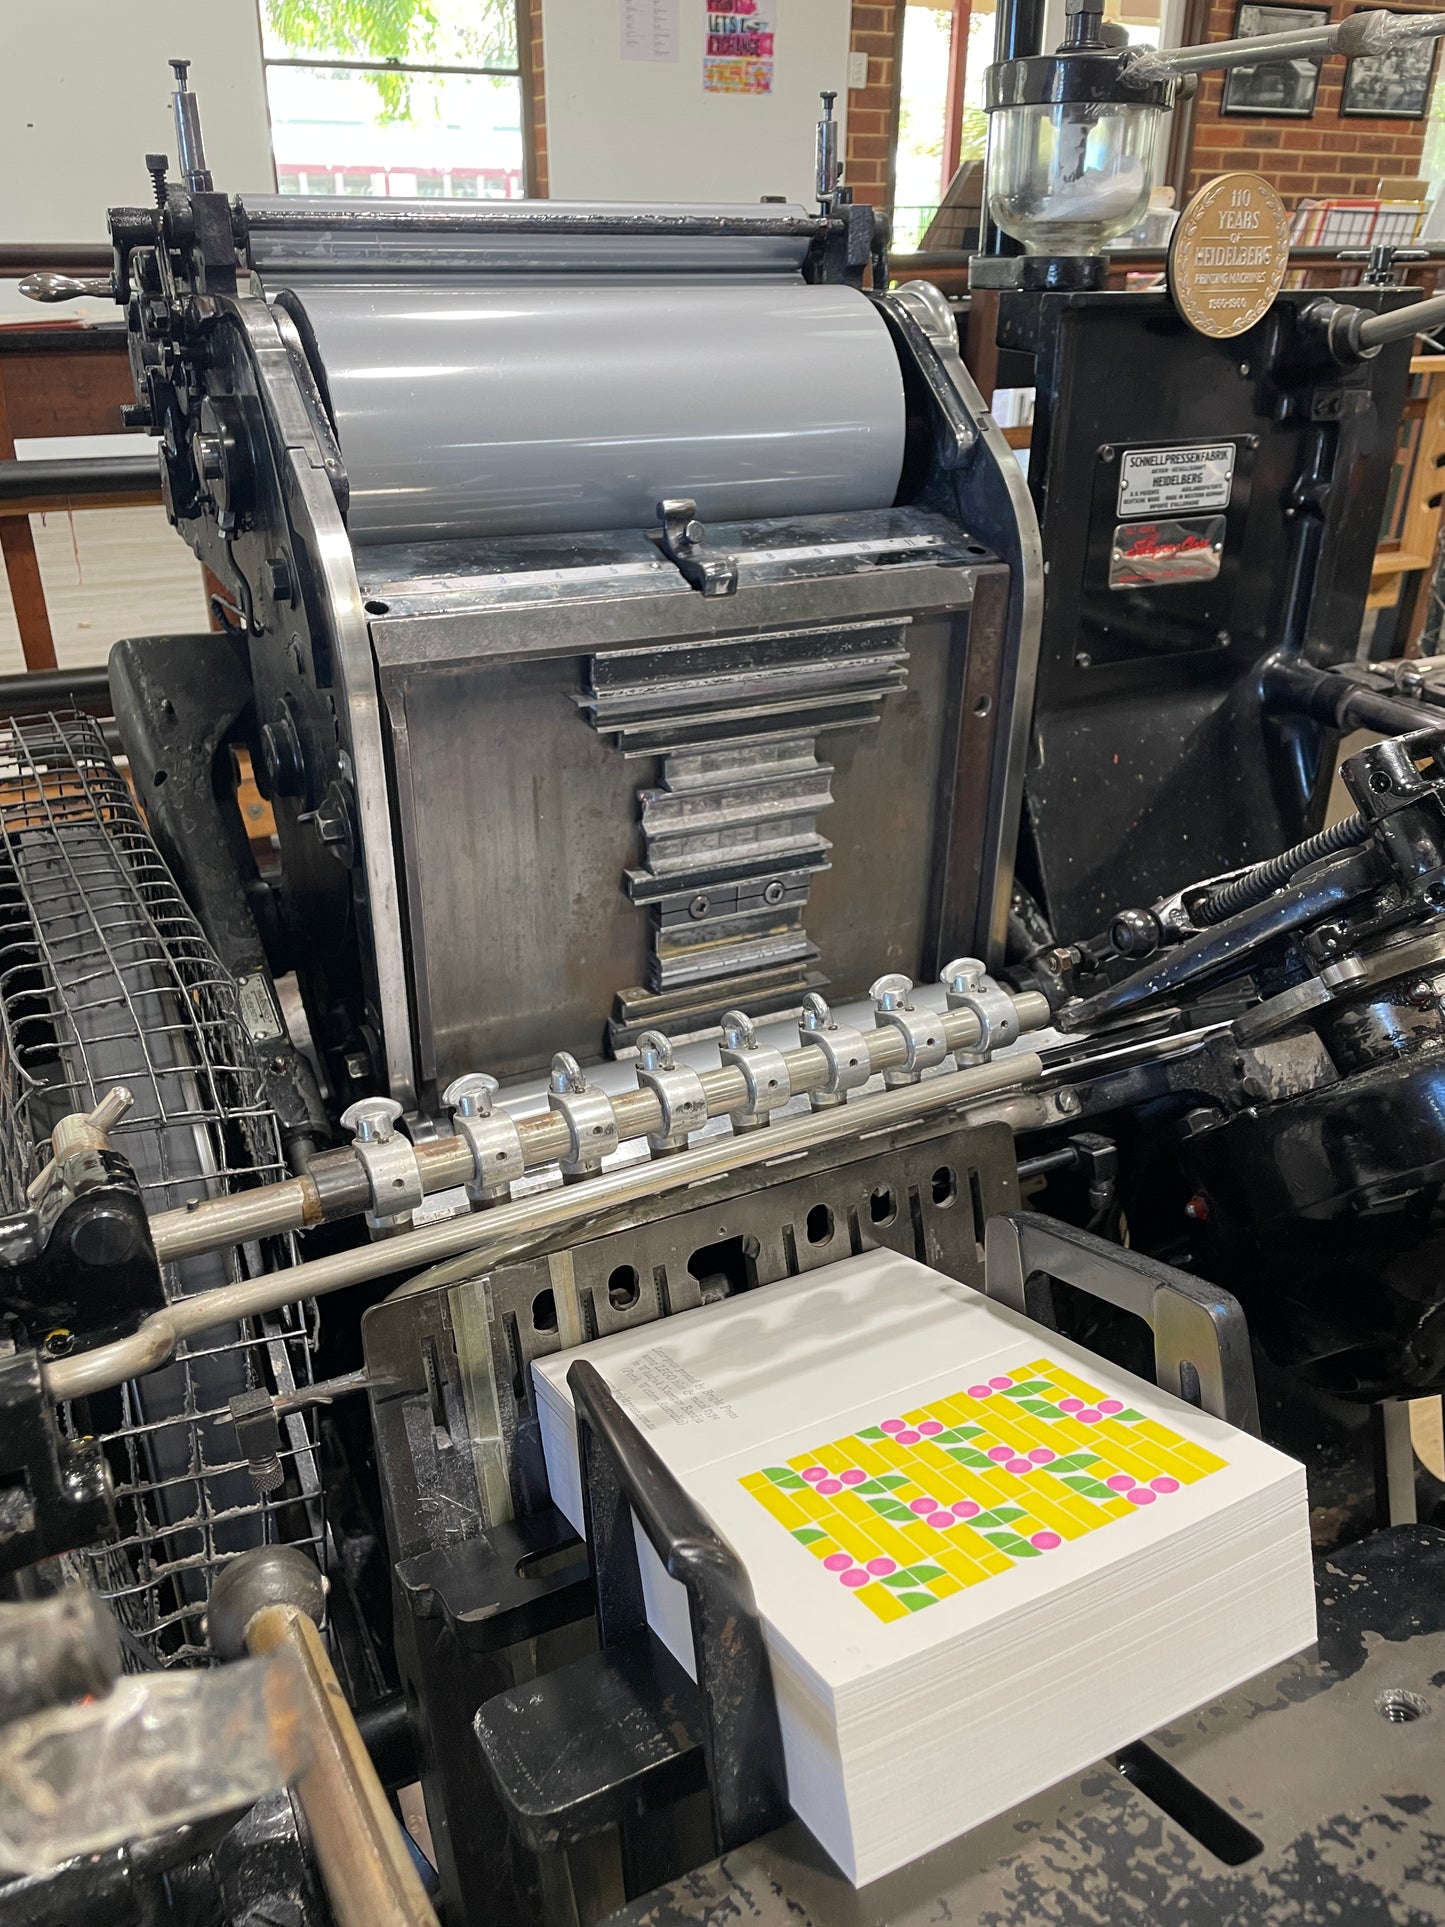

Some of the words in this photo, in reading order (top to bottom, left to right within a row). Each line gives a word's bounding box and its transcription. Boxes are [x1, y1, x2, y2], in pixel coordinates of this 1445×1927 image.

[1231, 189, 1251, 207] 110
[1218, 211, 1260, 230] YEARS
[1230, 233, 1242, 244] OF
[1194, 246, 1272, 267] HEIDELBERG
[1195, 273, 1228, 285] PRINTING
[1228, 272, 1266, 284] MACHINES
[1130, 450, 1229, 468] SCHNELLPRESSENFABRIK
[1152, 473, 1204, 487] HEIDELBERG
[858, 542, 872, 551] 10
[904, 538, 916, 547] 11
[654, 1364, 678, 1381] LEGO
